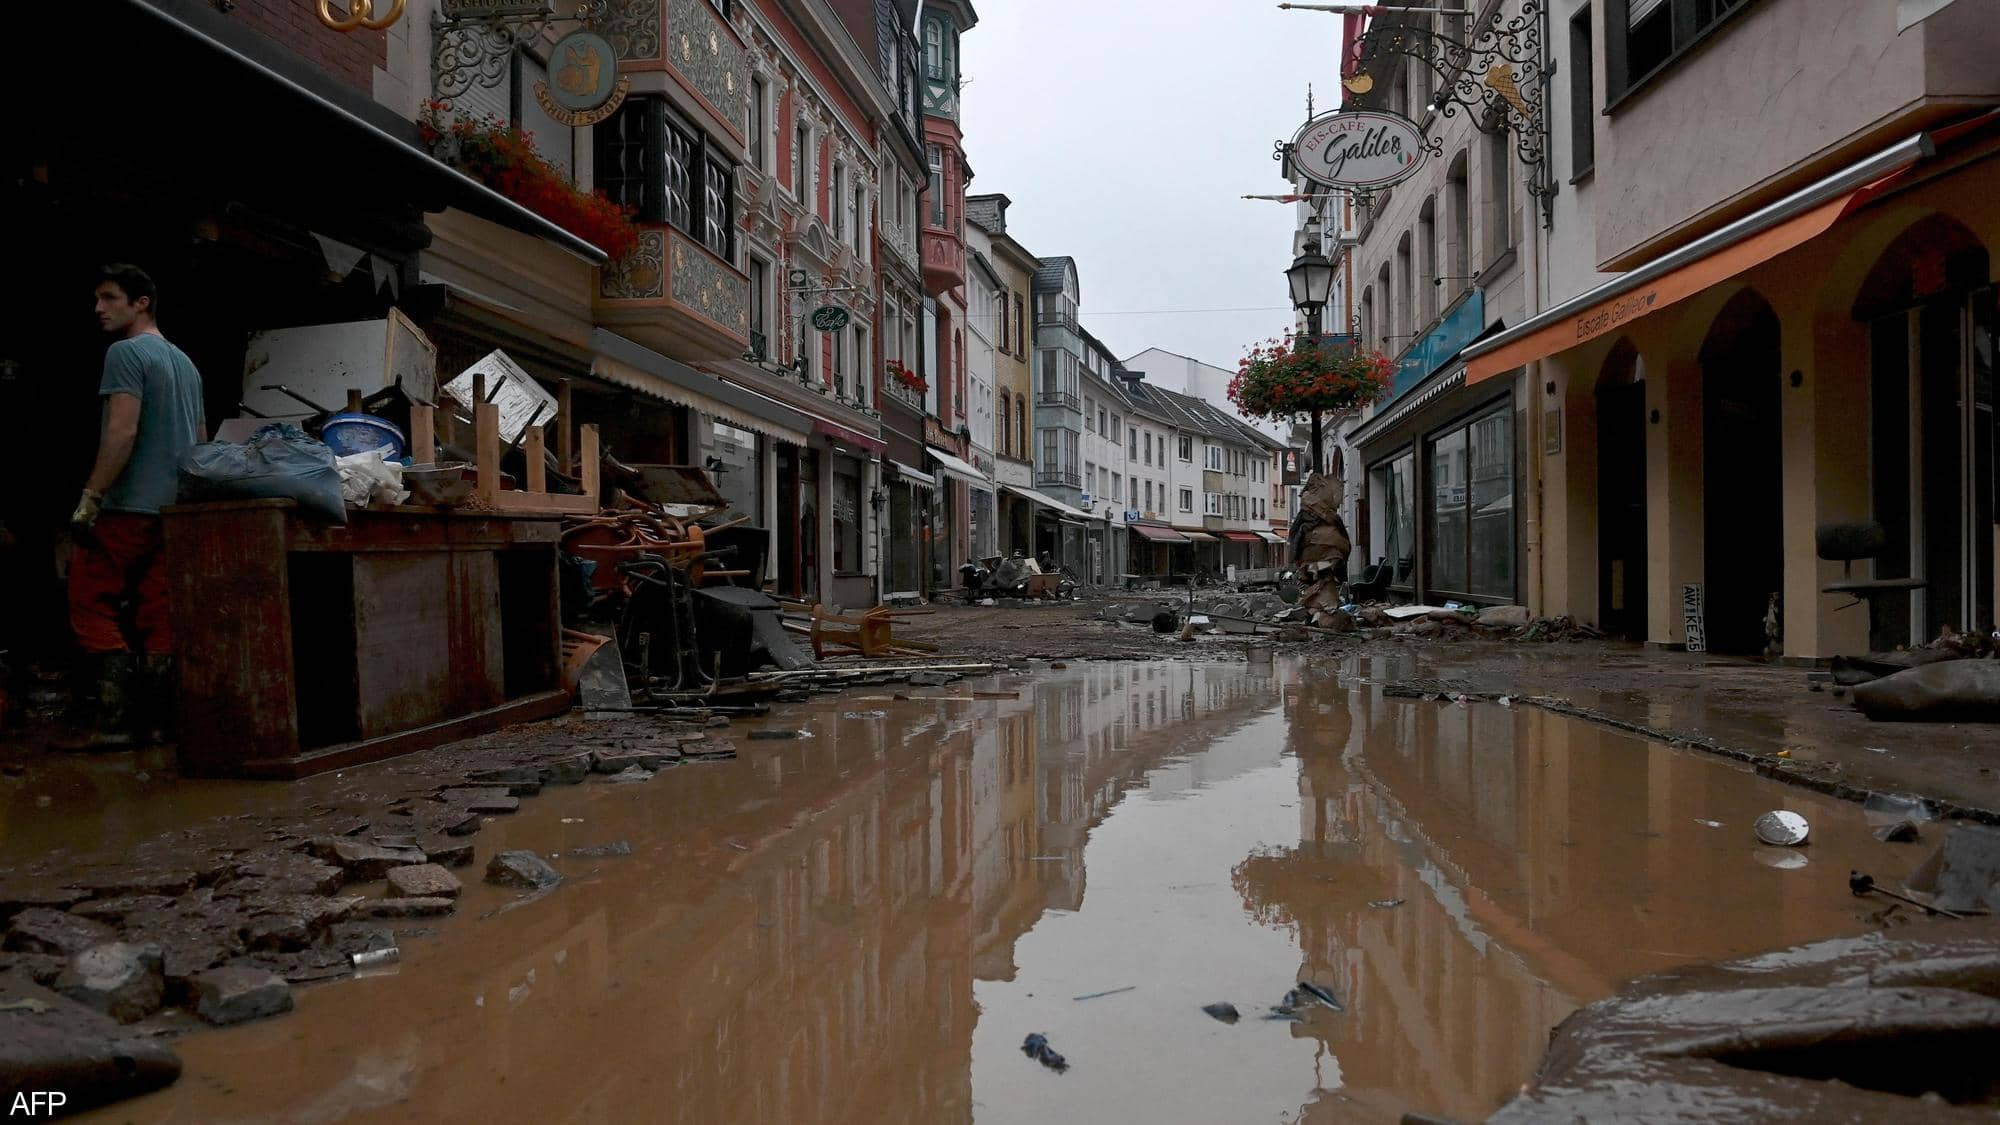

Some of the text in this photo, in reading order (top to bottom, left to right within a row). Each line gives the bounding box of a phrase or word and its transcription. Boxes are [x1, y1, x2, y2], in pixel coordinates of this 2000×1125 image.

[536, 90, 576, 124] SCHUH
[586, 87, 626, 123] SPORT
[1305, 120, 1366, 152] EIS-CAFE
[1323, 125, 1402, 180] Galileo
